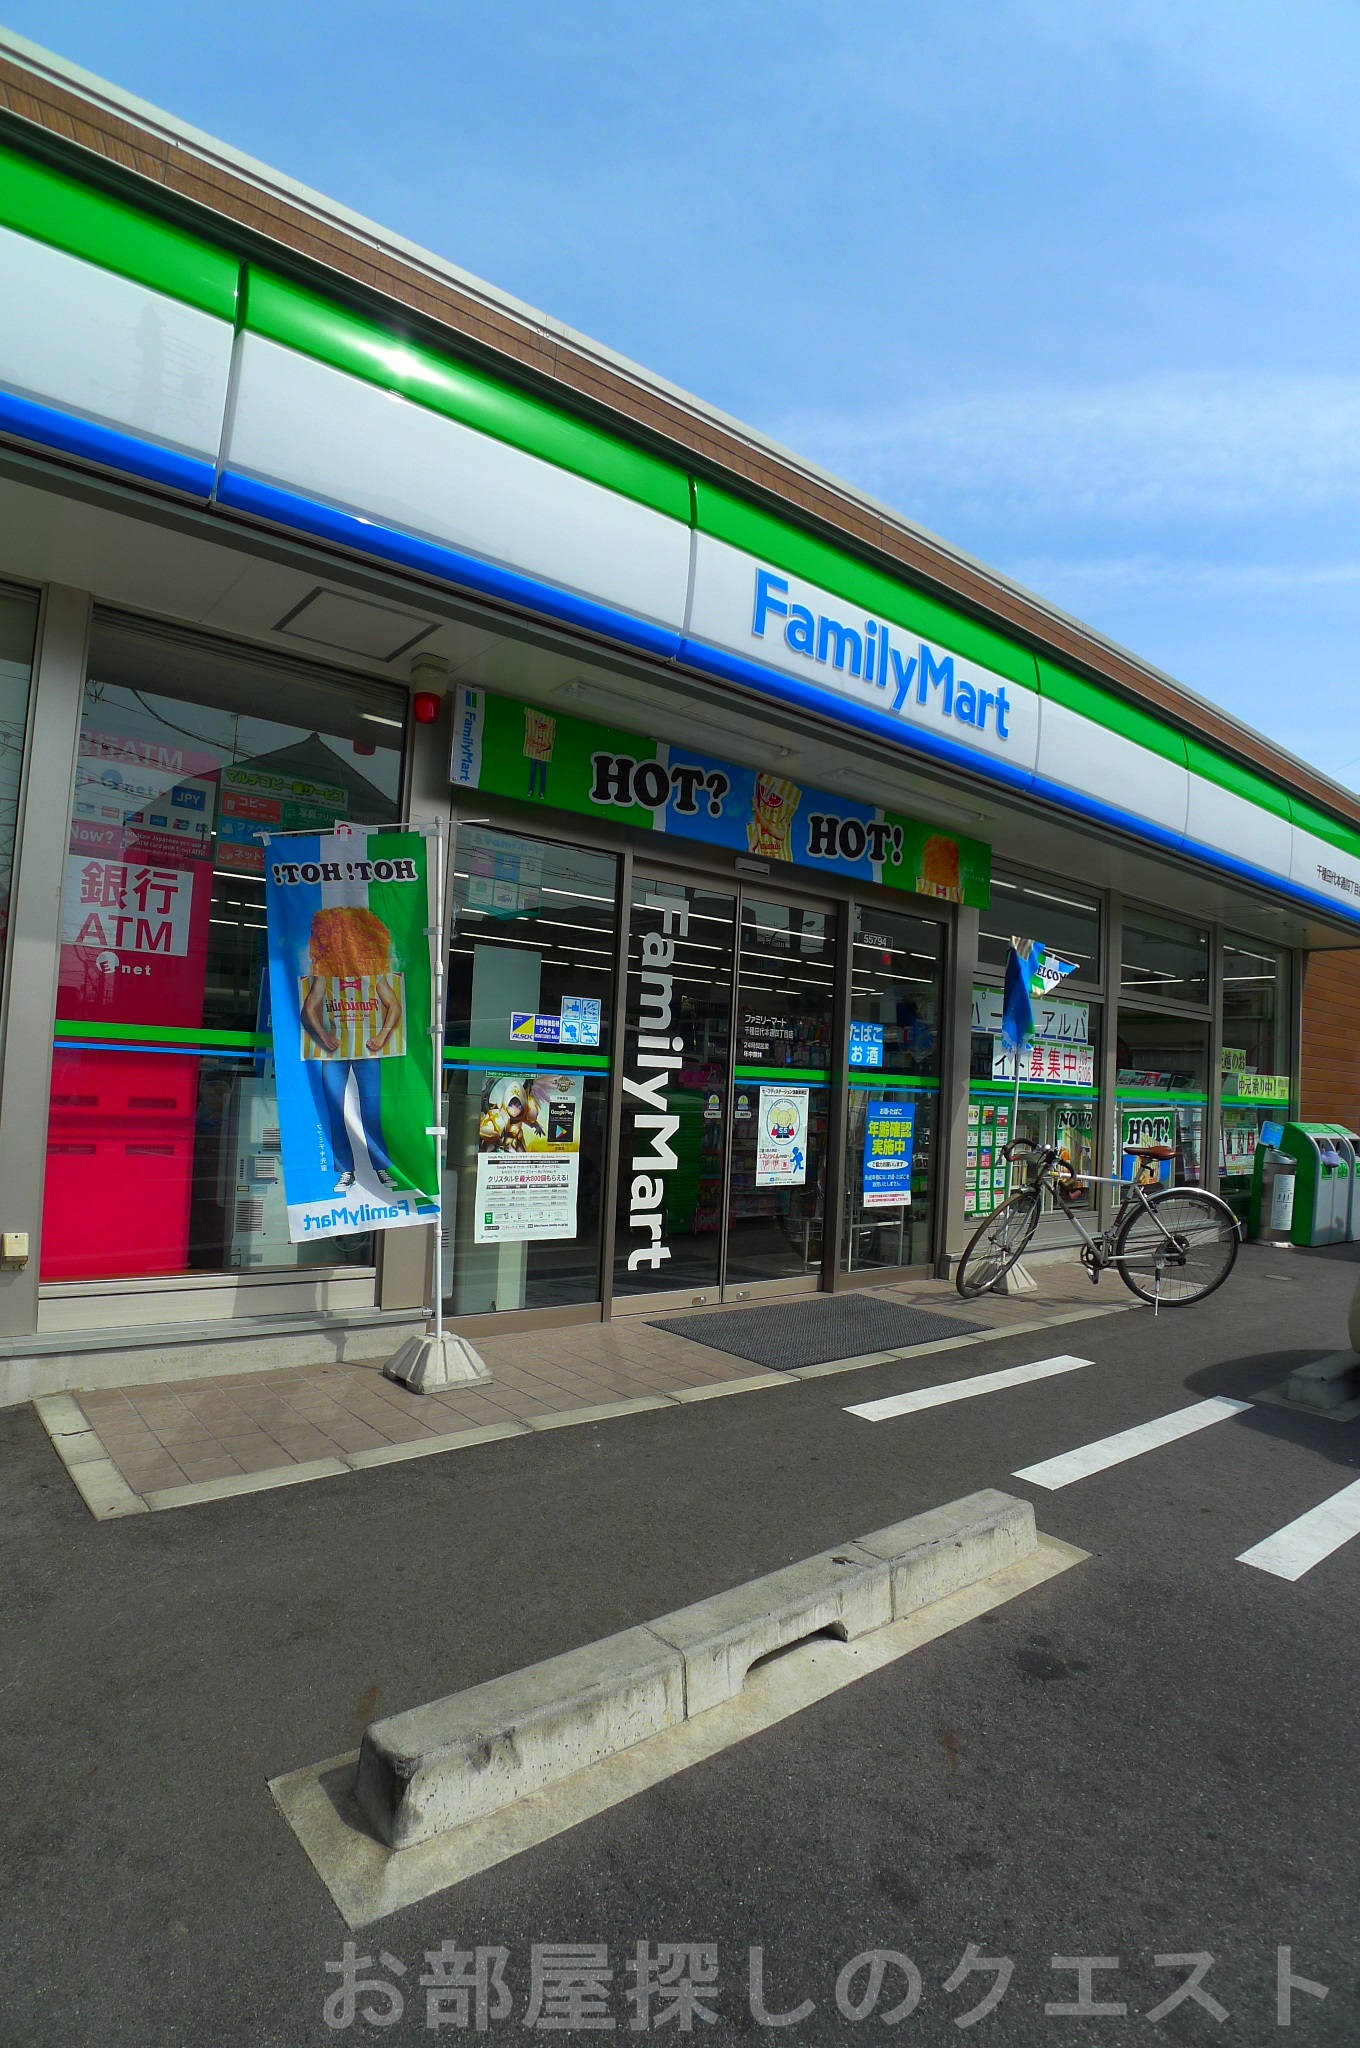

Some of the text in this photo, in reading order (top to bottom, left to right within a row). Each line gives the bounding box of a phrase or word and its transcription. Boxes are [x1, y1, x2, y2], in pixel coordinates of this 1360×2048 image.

[752, 566, 1010, 740] FamilyMart
[459, 711, 476, 782] FamilyMart
[590, 753, 730, 817] HOT?
[177, 793, 201, 806] JPY
[239, 797, 268, 808] コピー
[71, 826, 114, 845] Now?
[808, 813, 904, 865] HOT!
[234, 850, 266, 863] ネット
[80, 861, 179, 915] 銀行
[75, 912, 173, 953] ATM
[863, 934, 887, 947] 55794
[744, 1014, 787, 1027] ファミリーマート
[539, 1027, 556, 1035] システム
[849, 1023, 883, 1043] たばこ
[850, 1045, 879, 1065] お酒
[622, 893, 690, 1272] FamilyMart
[868, 1120, 912, 1138] 年齢確認
[1127, 1117, 1170, 1145] HOT!
[871, 1138, 906, 1156] 実施中
